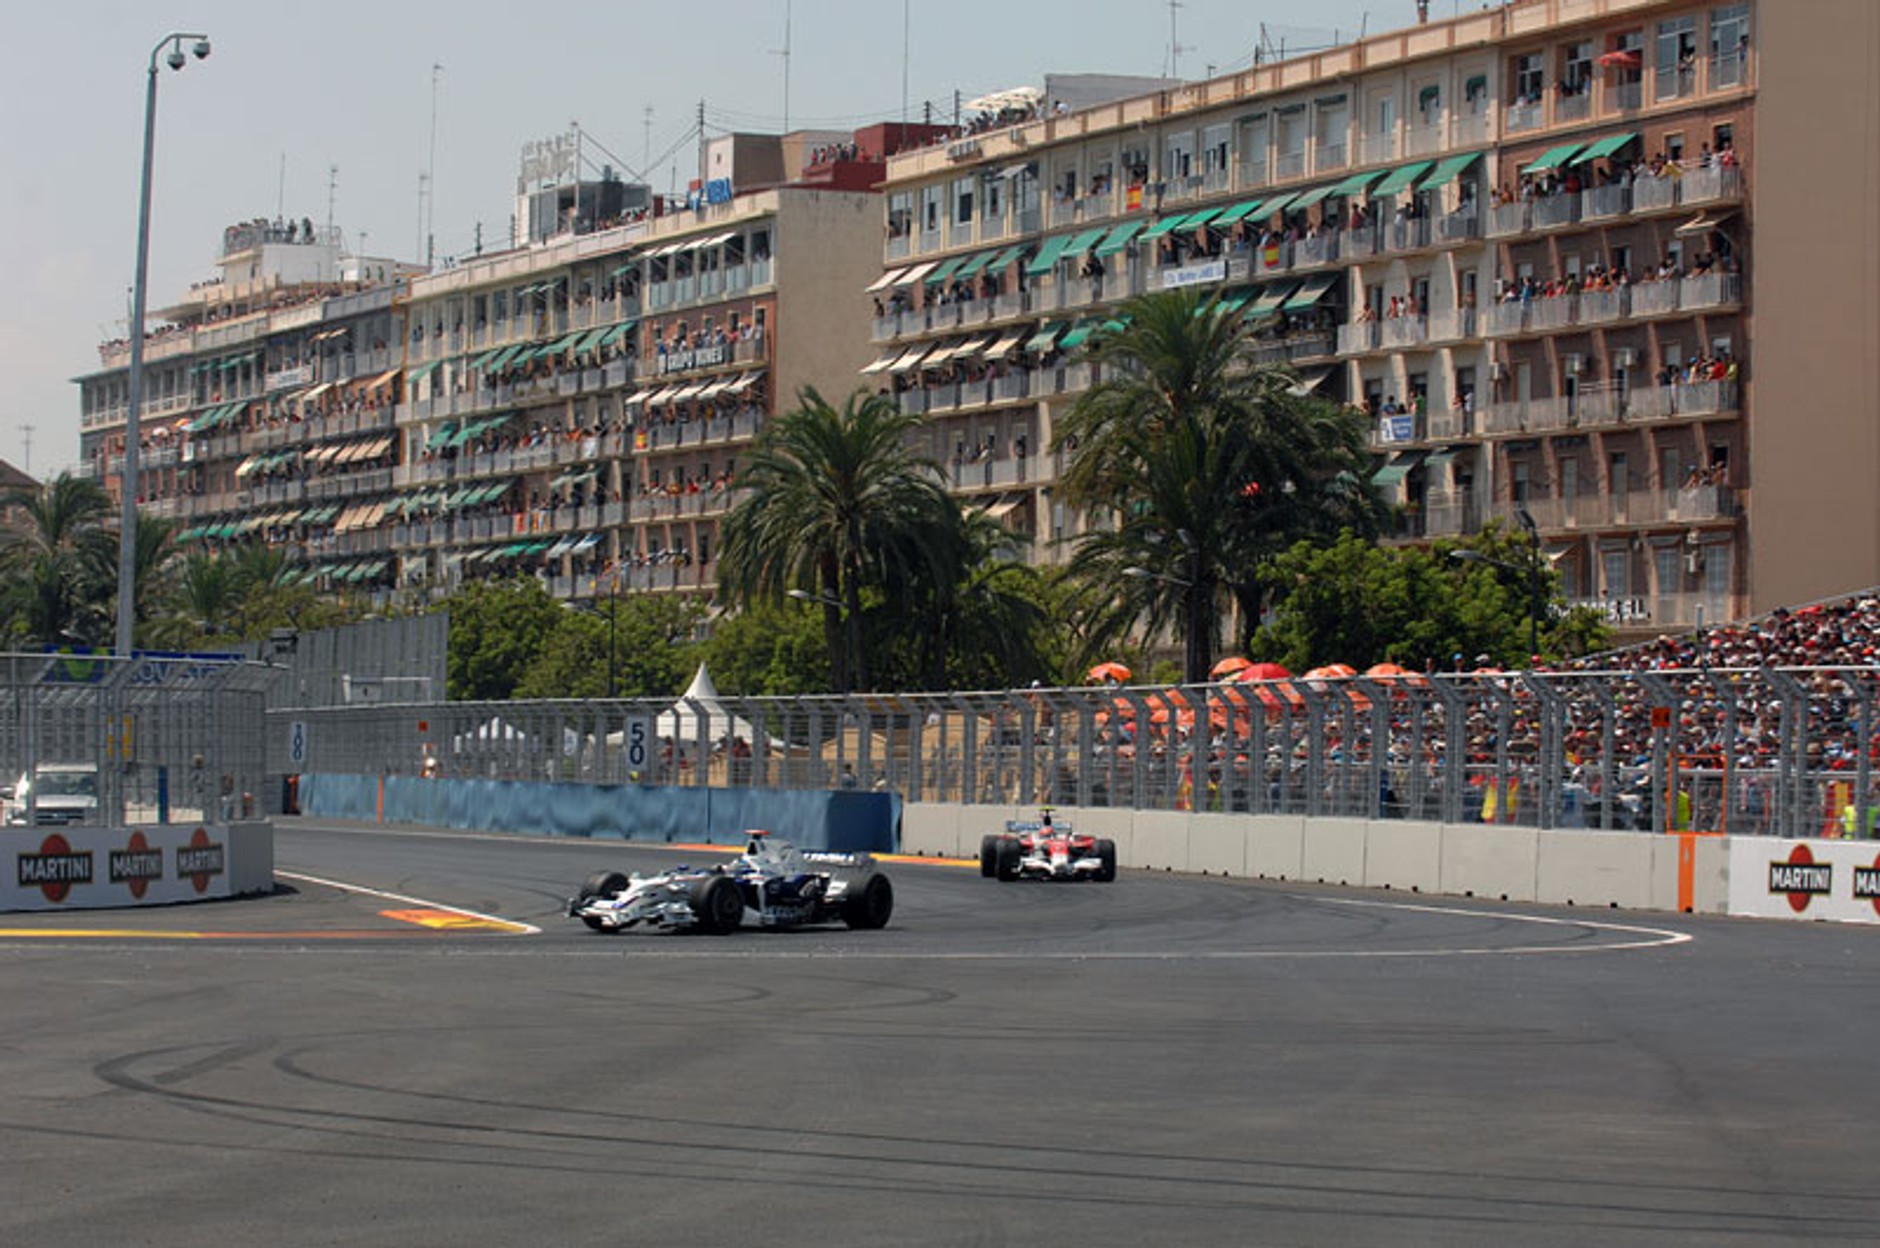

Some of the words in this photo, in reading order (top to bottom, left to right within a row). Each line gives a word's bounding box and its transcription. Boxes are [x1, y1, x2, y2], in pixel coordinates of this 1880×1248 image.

[630, 722, 645, 765] 50
[21, 856, 89, 881] MARTINI
[112, 853, 160, 877] MARTINI
[178, 848, 221, 874] MARTINI
[1771, 866, 1830, 890] MARTINI
